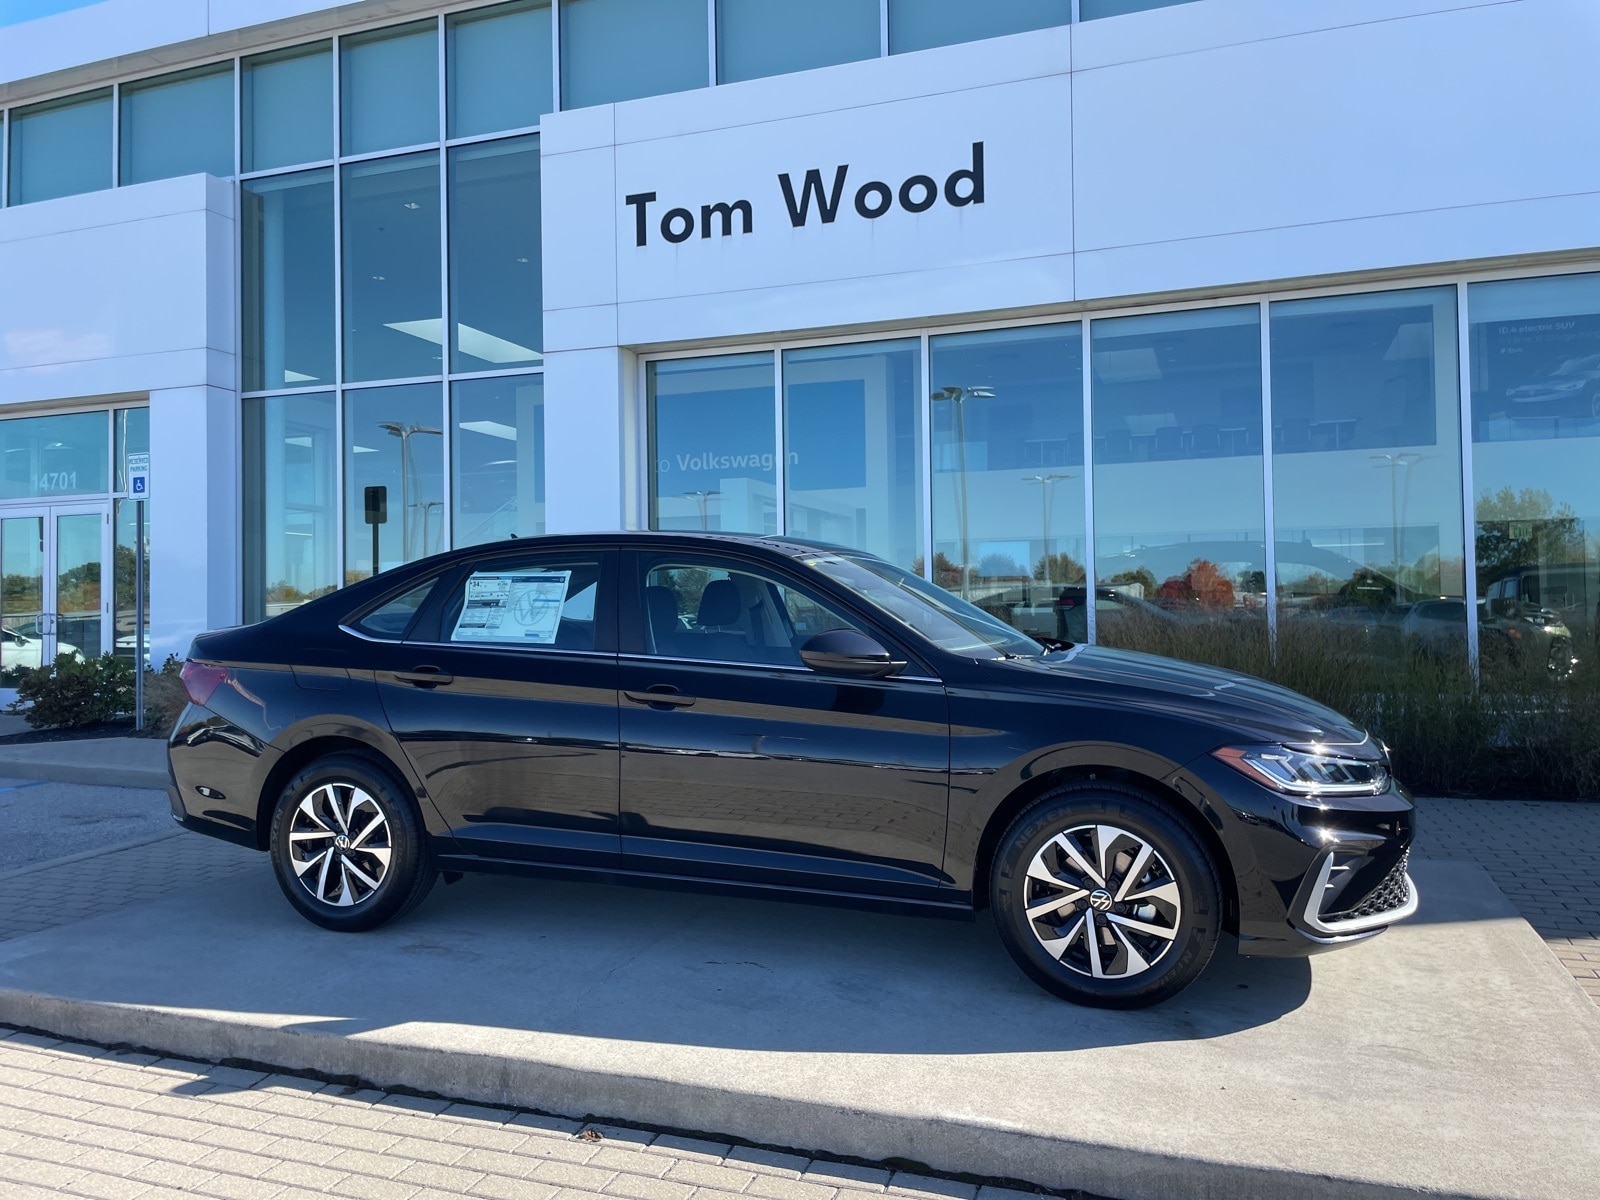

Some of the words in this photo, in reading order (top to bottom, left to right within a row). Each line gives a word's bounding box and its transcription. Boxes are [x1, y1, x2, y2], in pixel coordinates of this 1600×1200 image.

[625, 191, 752, 247] Tom
[777, 141, 985, 228] Wood
[1555, 320, 1576, 331] SUV
[676, 451, 799, 472] Volkswagn
[31, 471, 77, 492] 14701
[1015, 806, 1072, 849] NEXEN
